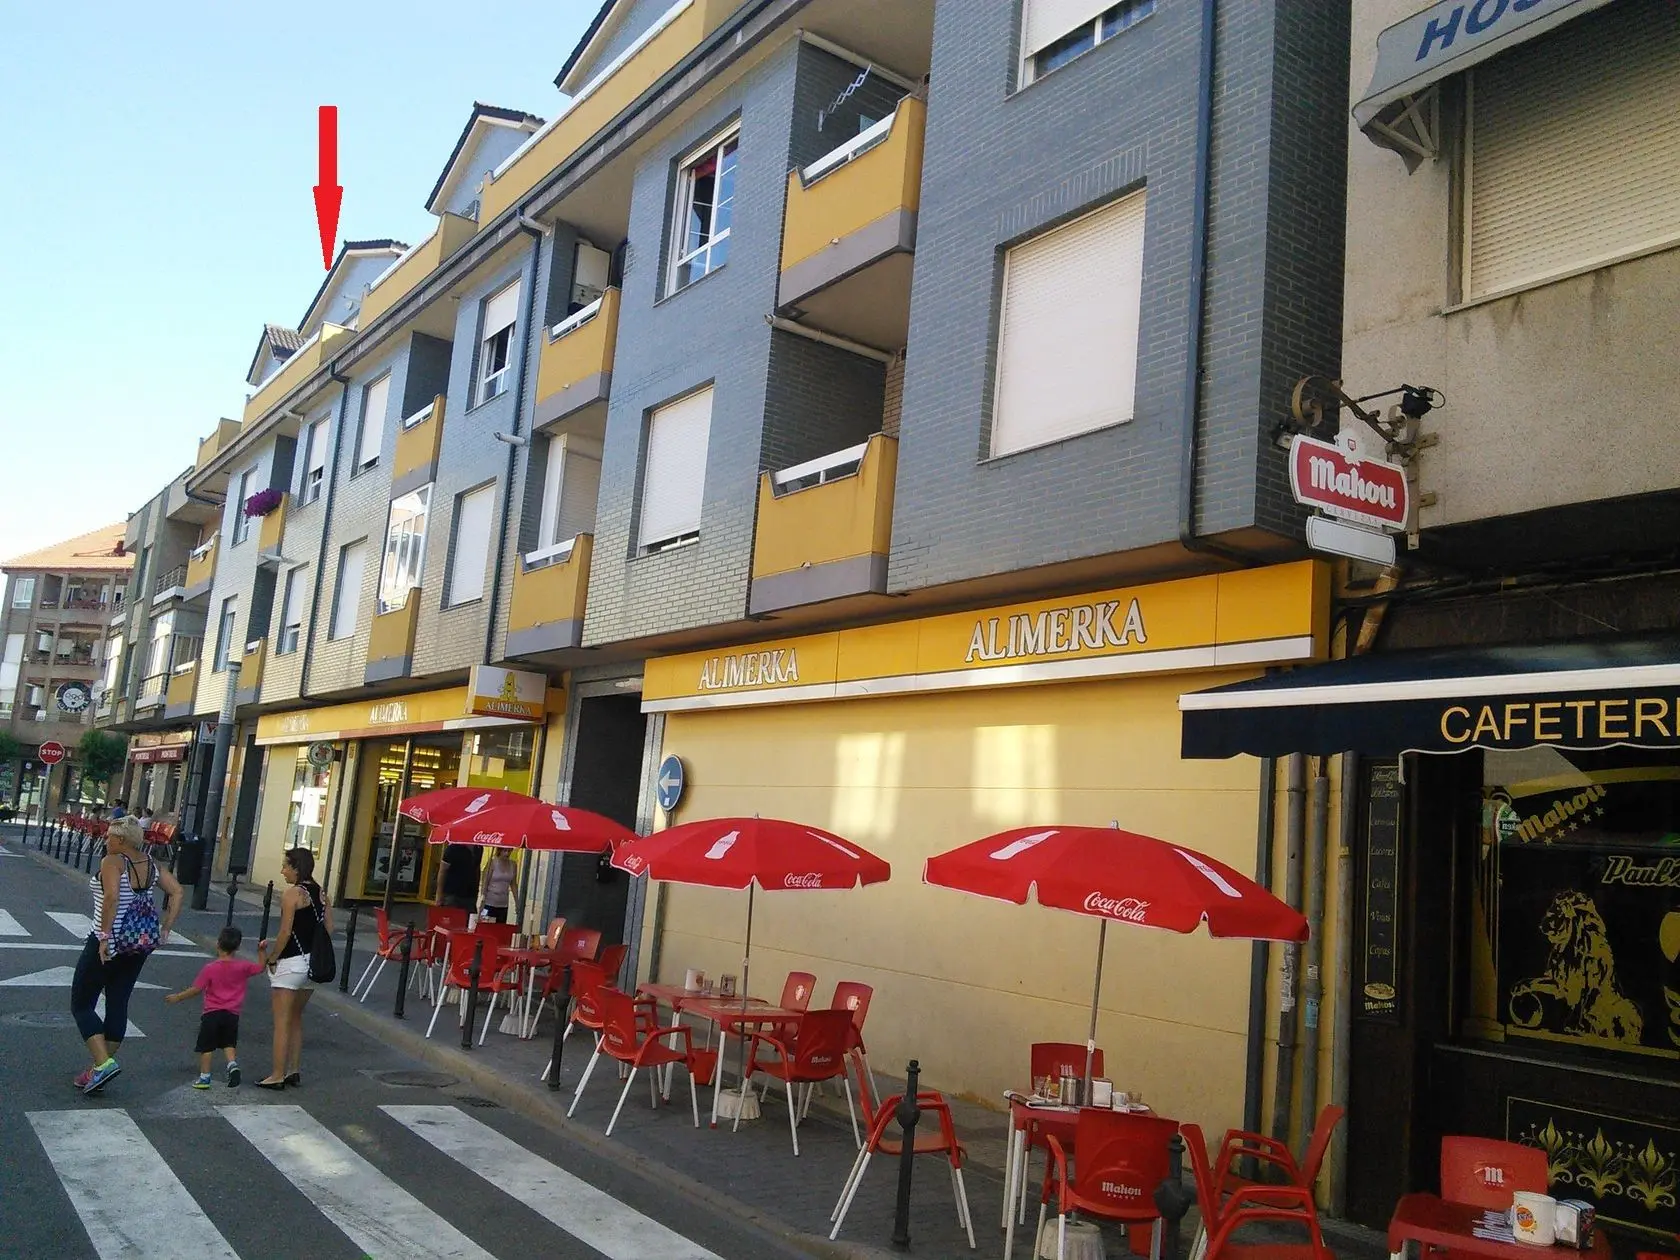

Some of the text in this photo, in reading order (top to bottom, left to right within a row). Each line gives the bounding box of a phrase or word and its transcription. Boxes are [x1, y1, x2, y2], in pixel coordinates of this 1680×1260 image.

[1415, 0, 1541, 62] HO
[1309, 456, 1396, 509] Mahou
[965, 598, 1147, 663] ALIMERKA
[697, 648, 799, 690] ALIMERKA
[486, 701, 532, 715] ALIMERKA
[41, 748, 62, 757] STOP
[1516, 784, 1607, 843] Mahou
[1084, 891, 1151, 923] Coca-Cola
[1102, 1181, 1142, 1196] Mahou
